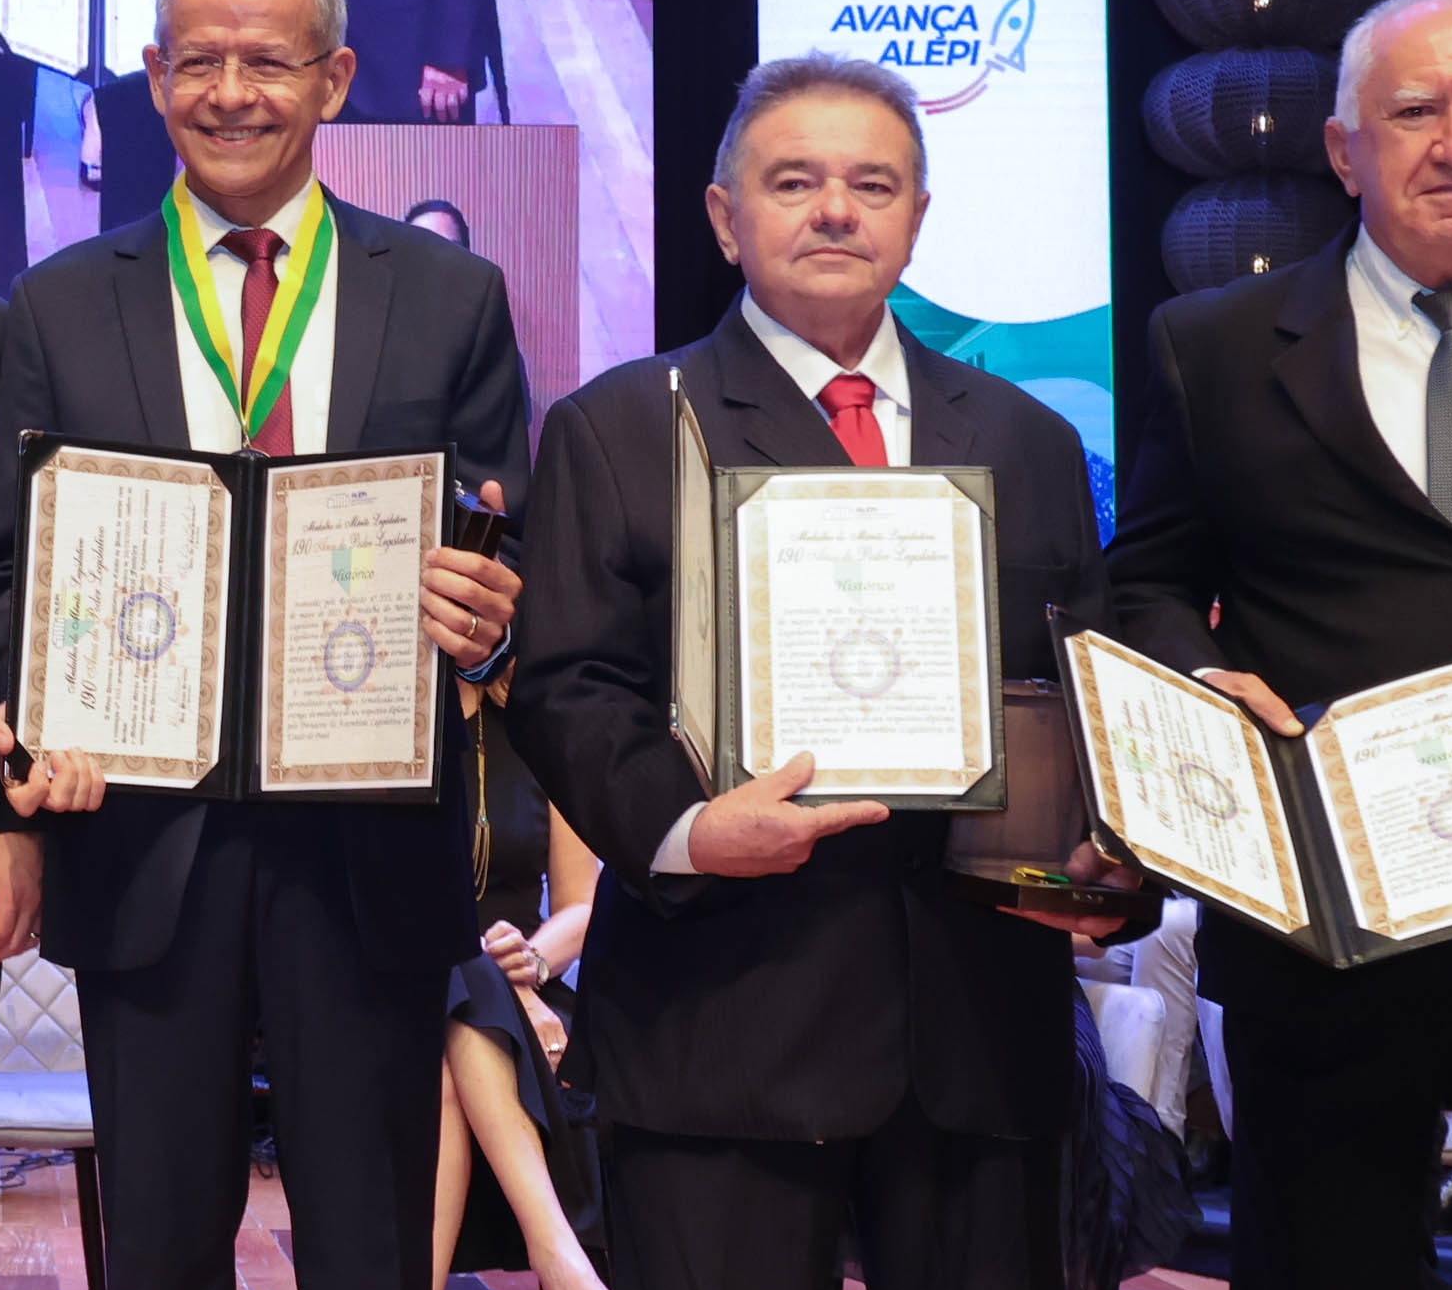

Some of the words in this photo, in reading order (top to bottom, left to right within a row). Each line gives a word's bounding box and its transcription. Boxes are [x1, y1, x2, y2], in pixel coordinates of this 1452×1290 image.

[831, 5, 978, 39] AVANÇA
[878, 40, 981, 66] ALEPI
[292, 537, 312, 556] 190
[80, 679, 98, 711] 190
[1353, 744, 1382, 765] 190
